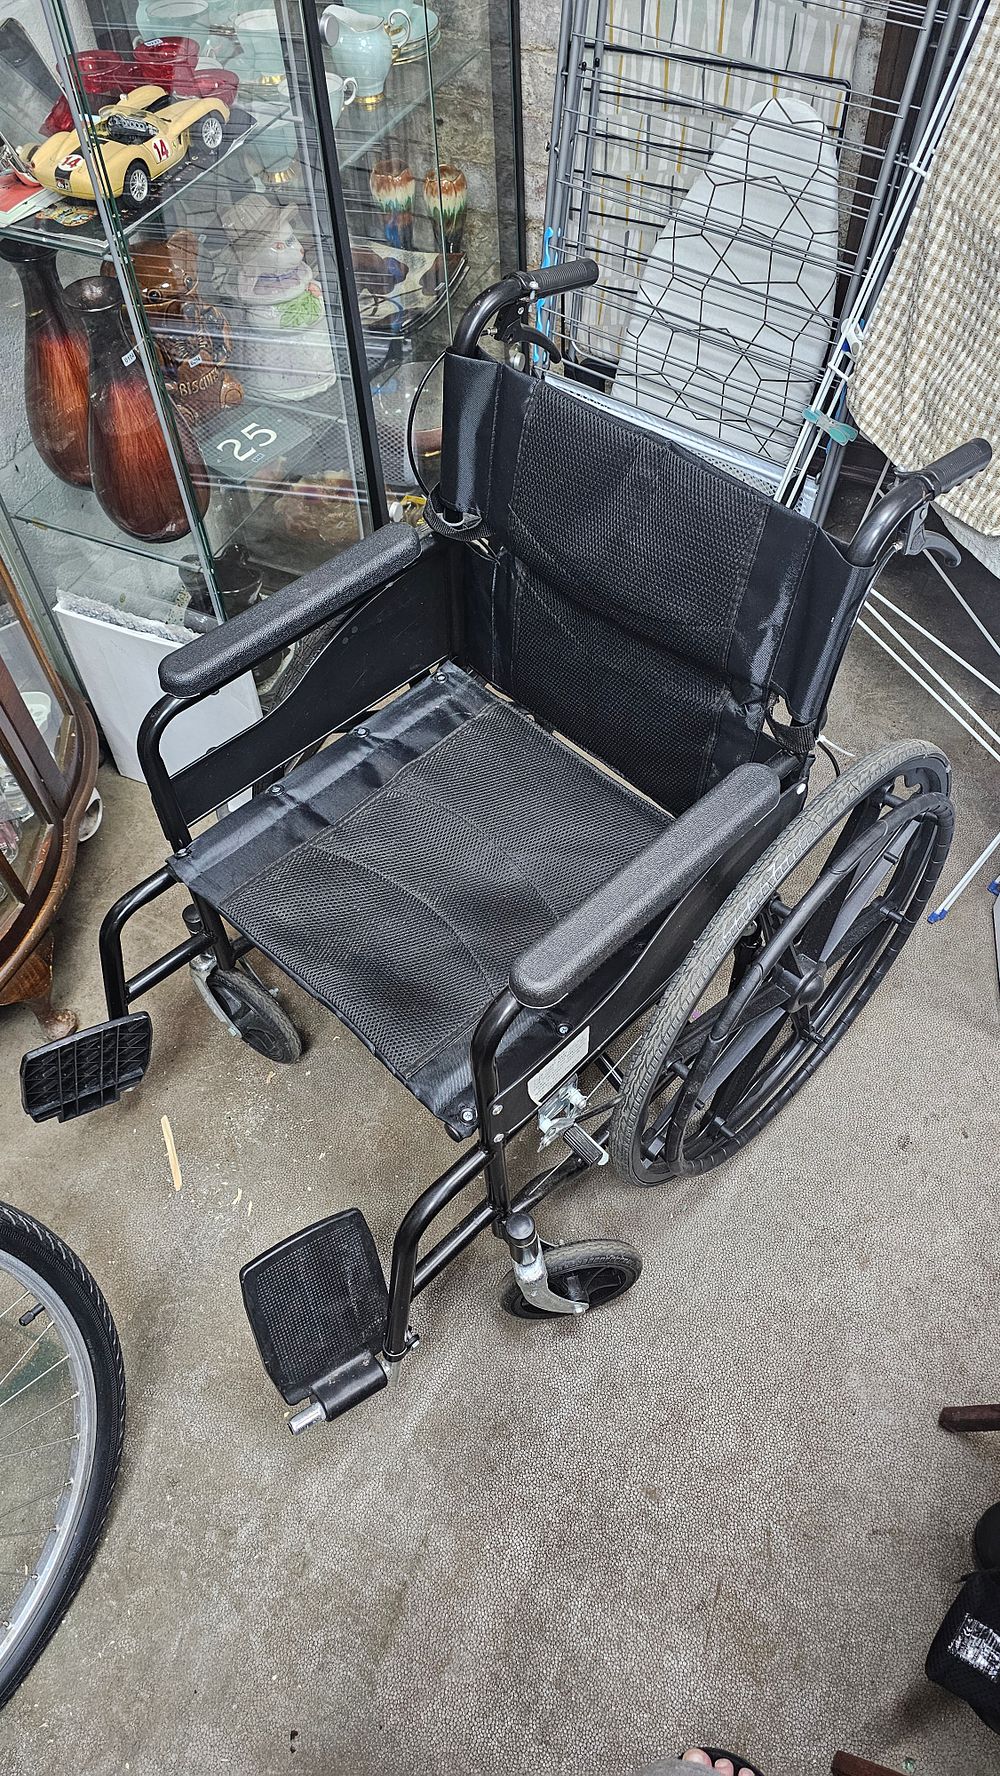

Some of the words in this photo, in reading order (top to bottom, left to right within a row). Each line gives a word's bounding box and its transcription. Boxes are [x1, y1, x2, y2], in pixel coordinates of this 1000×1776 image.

[153, 139, 169, 161] 14
[61, 156, 81, 168] 14
[216, 422, 277, 462] 25
